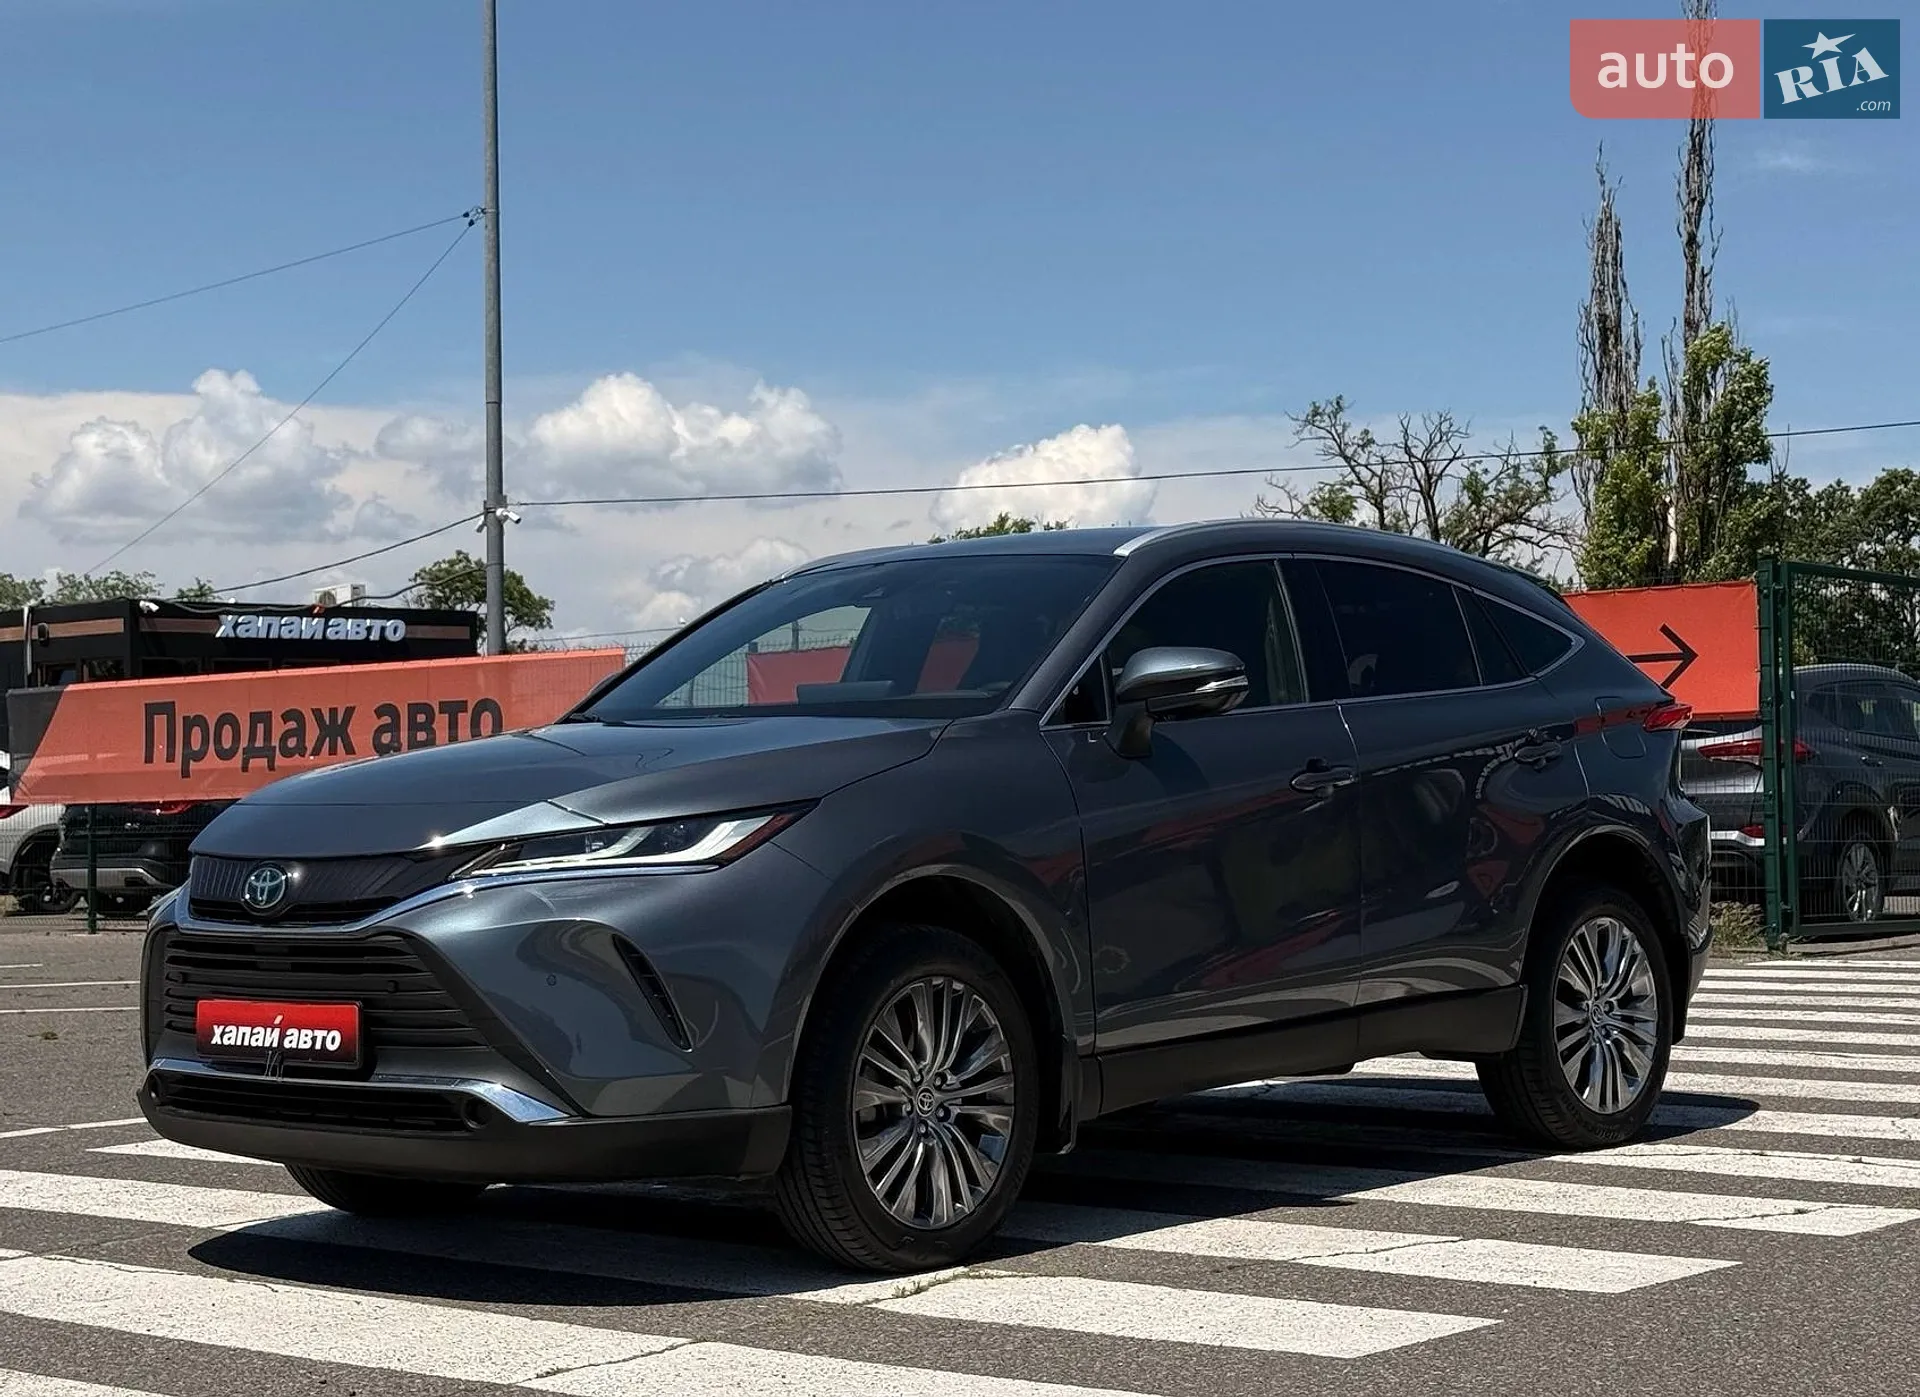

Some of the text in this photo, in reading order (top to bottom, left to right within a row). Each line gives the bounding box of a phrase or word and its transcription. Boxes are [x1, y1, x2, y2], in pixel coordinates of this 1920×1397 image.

[325, 617, 406, 642] авто
[144, 697, 504, 779] Продаж авто
[283, 1027, 342, 1051] авто
